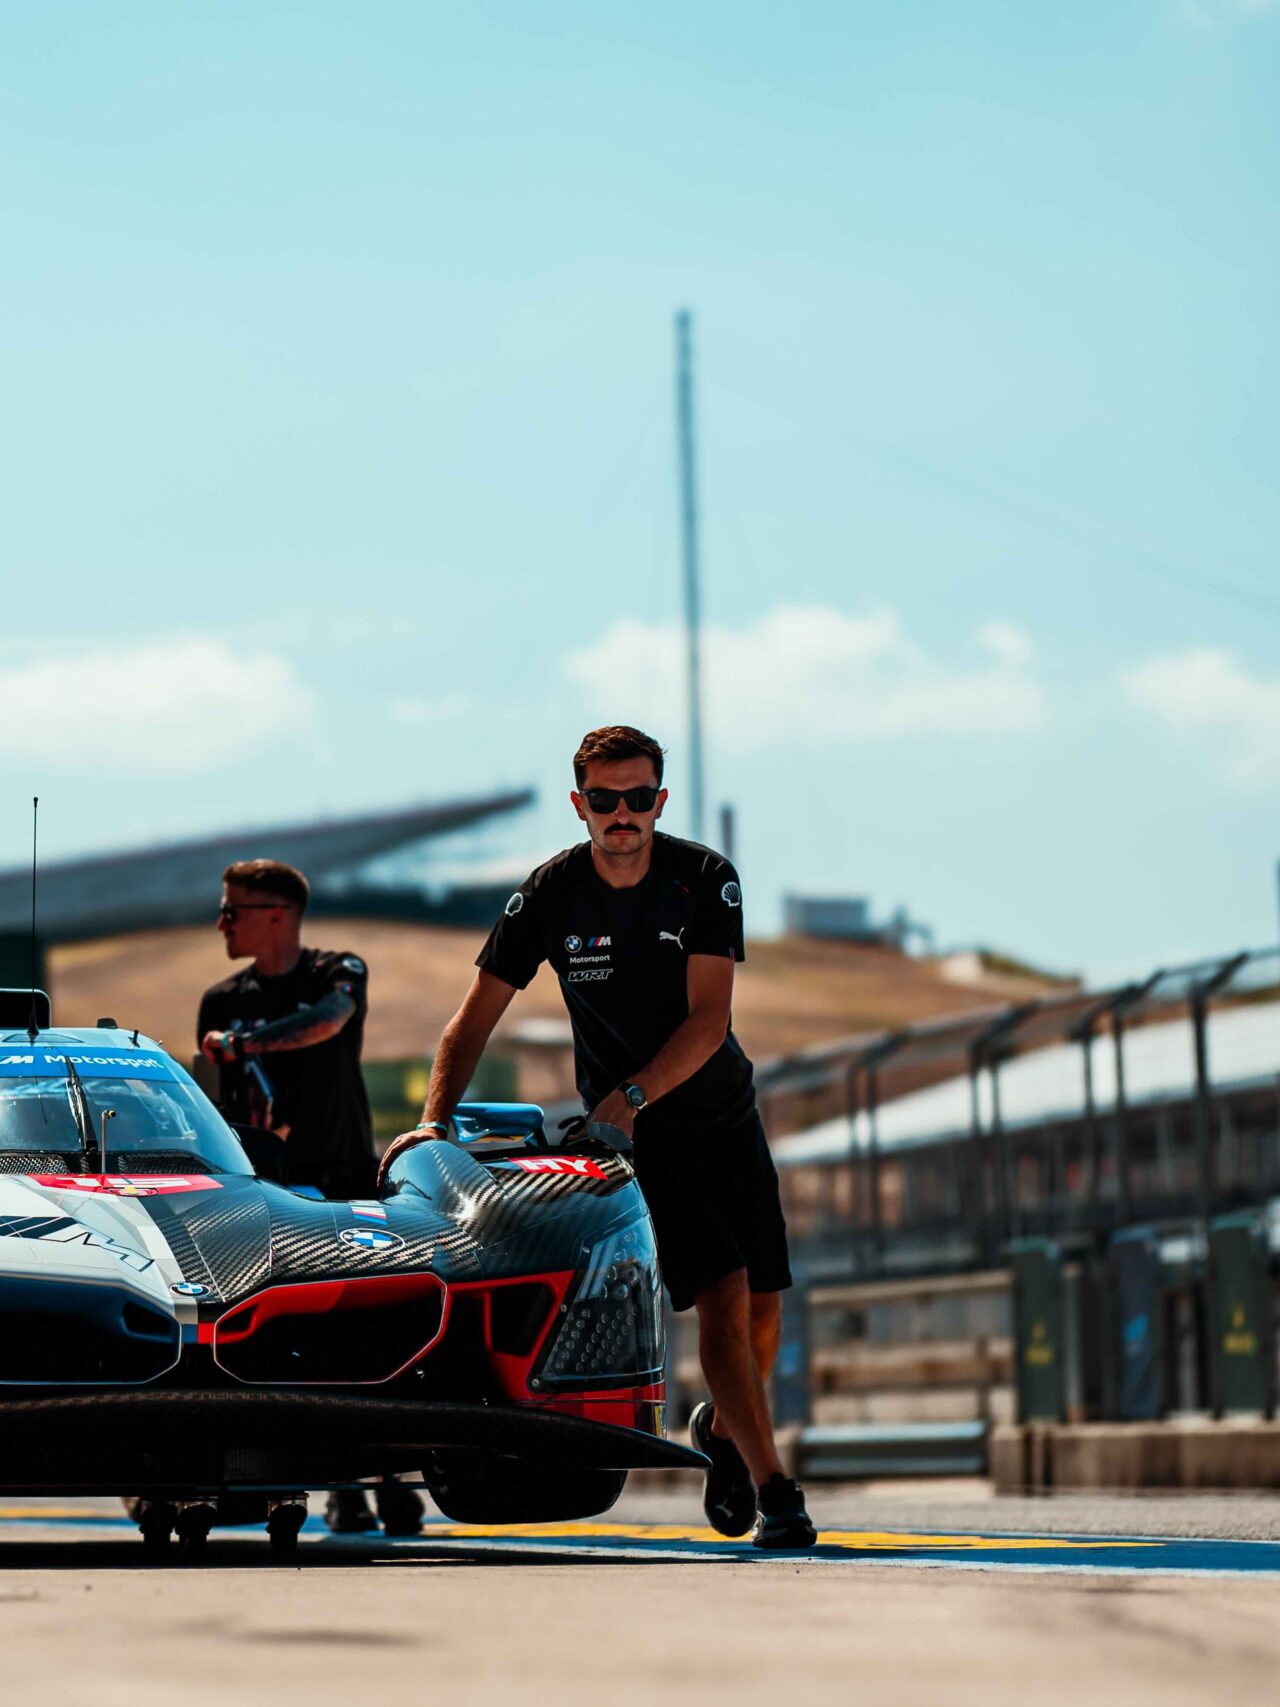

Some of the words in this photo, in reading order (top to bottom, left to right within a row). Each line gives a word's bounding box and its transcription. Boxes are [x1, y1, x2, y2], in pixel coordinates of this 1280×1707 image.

[569, 954, 610, 964] Motorsport
[568, 969, 613, 981] WRT
[44, 1054, 165, 1069] Motorsport
[517, 1158, 589, 1173] HY
